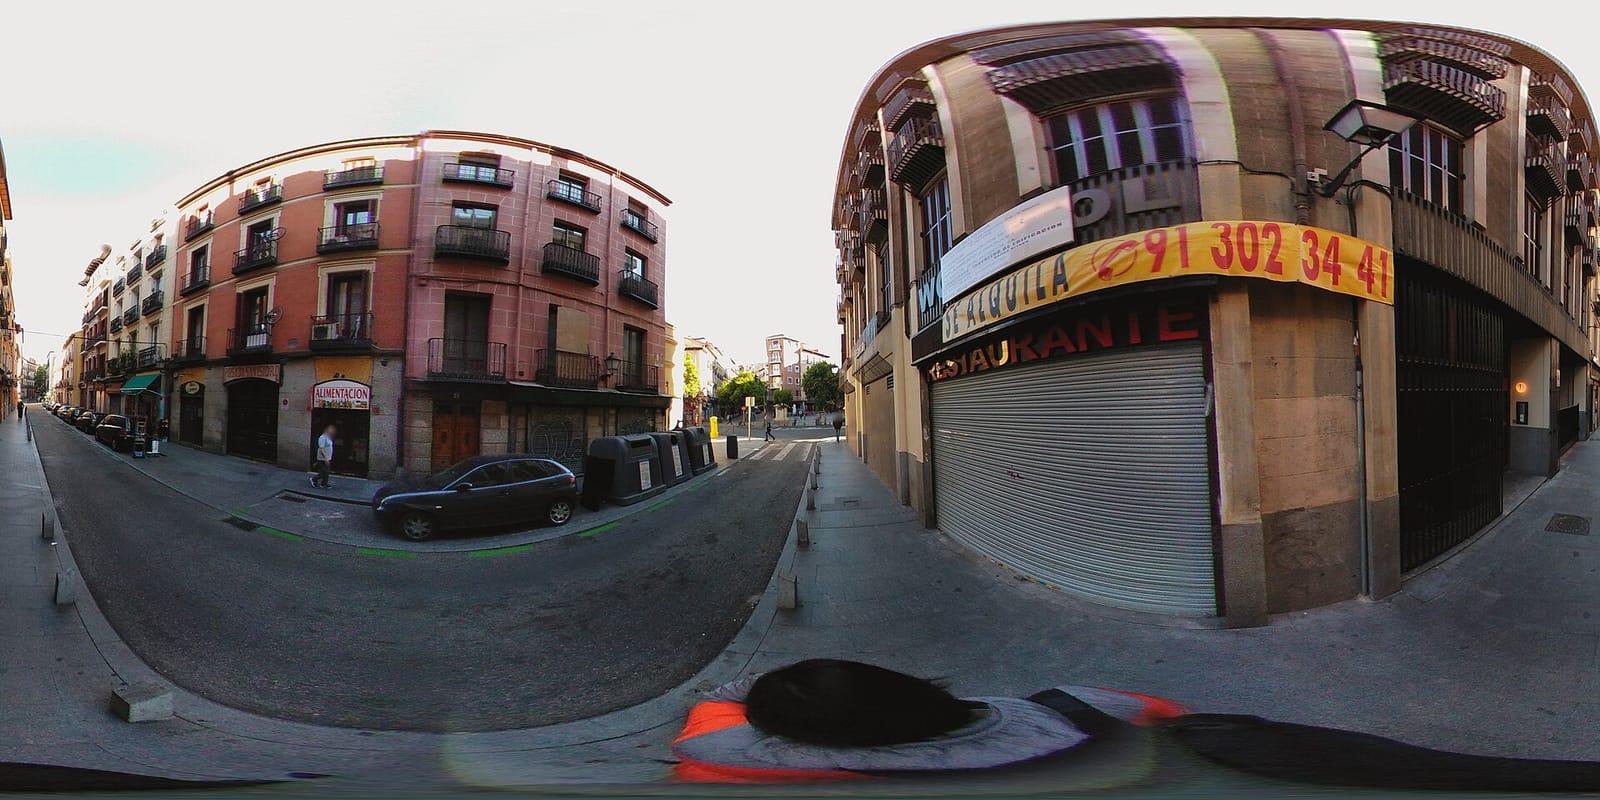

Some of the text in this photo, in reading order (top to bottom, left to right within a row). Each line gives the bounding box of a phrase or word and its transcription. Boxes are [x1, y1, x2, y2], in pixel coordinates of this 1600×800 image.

[944, 222, 1388, 338] SE ALQUILA 91 302 34 41
[927, 305, 1199, 383] RESTAURANTE
[315, 387, 368, 399] ALIMENTACION
